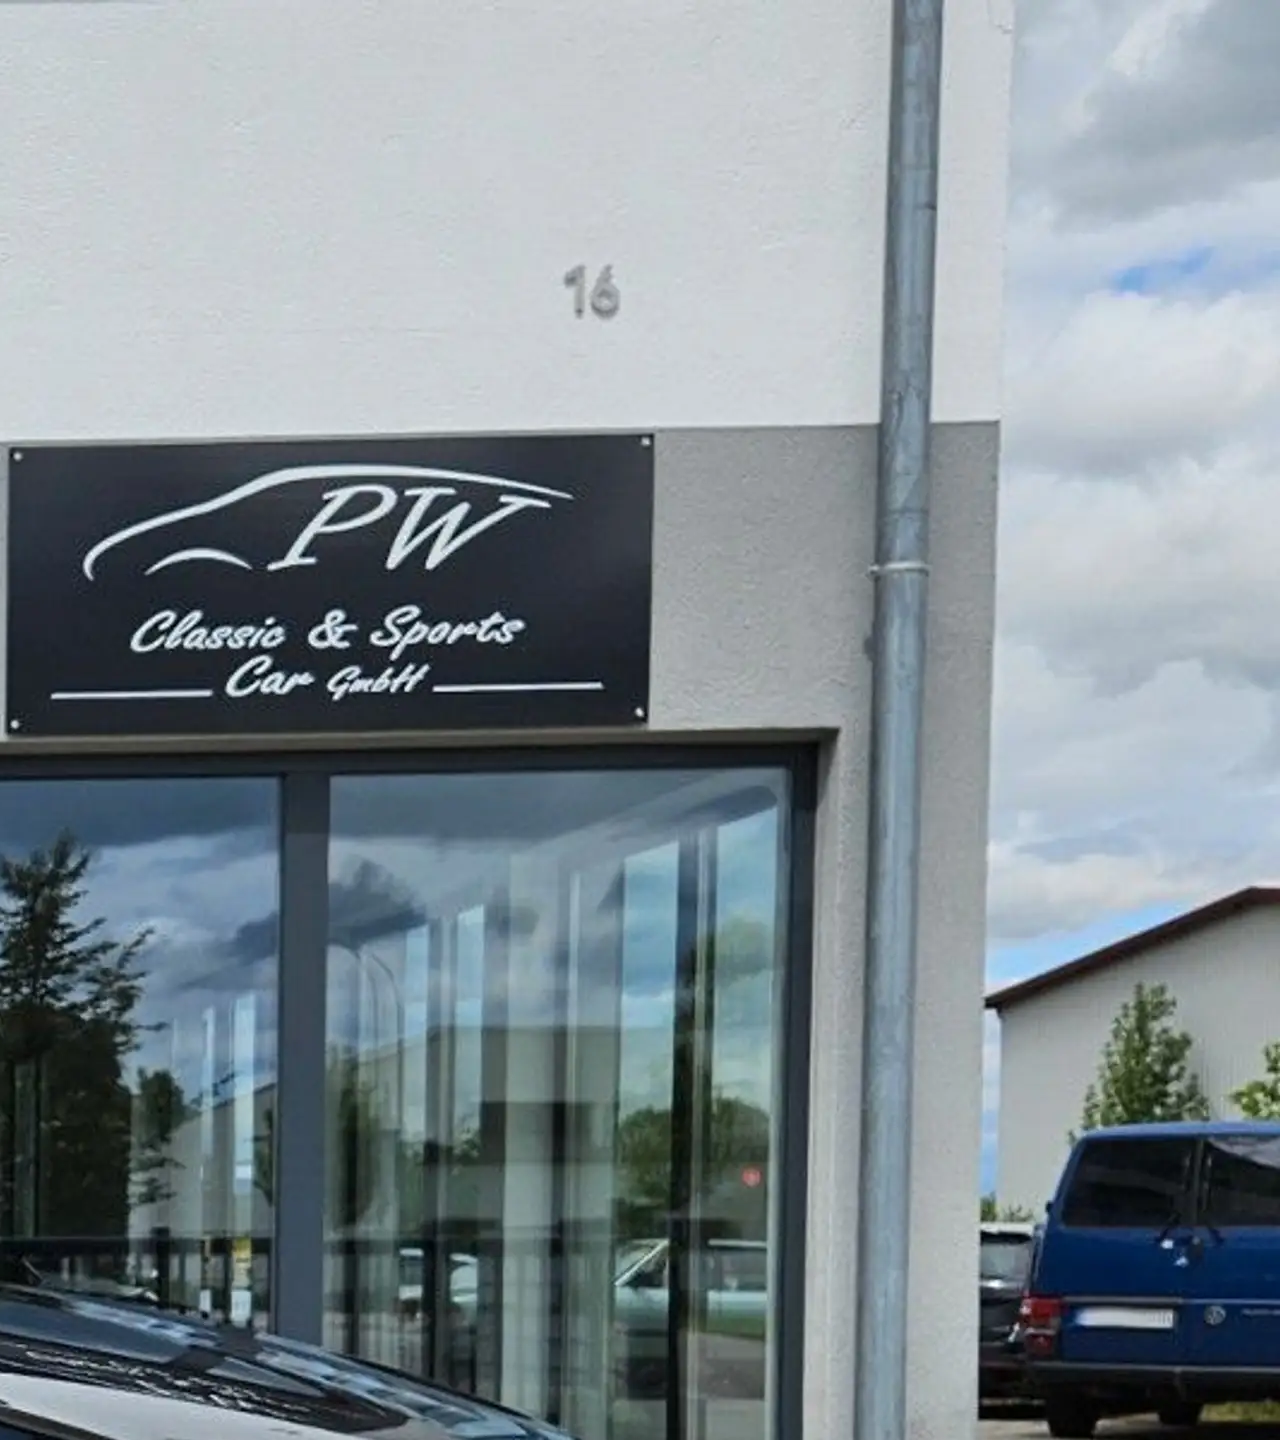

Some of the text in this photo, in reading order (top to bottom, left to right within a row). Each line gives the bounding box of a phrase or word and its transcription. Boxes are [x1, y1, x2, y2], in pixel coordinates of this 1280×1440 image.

[564, 264, 621, 320] 16
[267, 484, 552, 571] PW
[130, 604, 527, 660] Classic & Sports
[224, 654, 431, 700] Car GmbH
